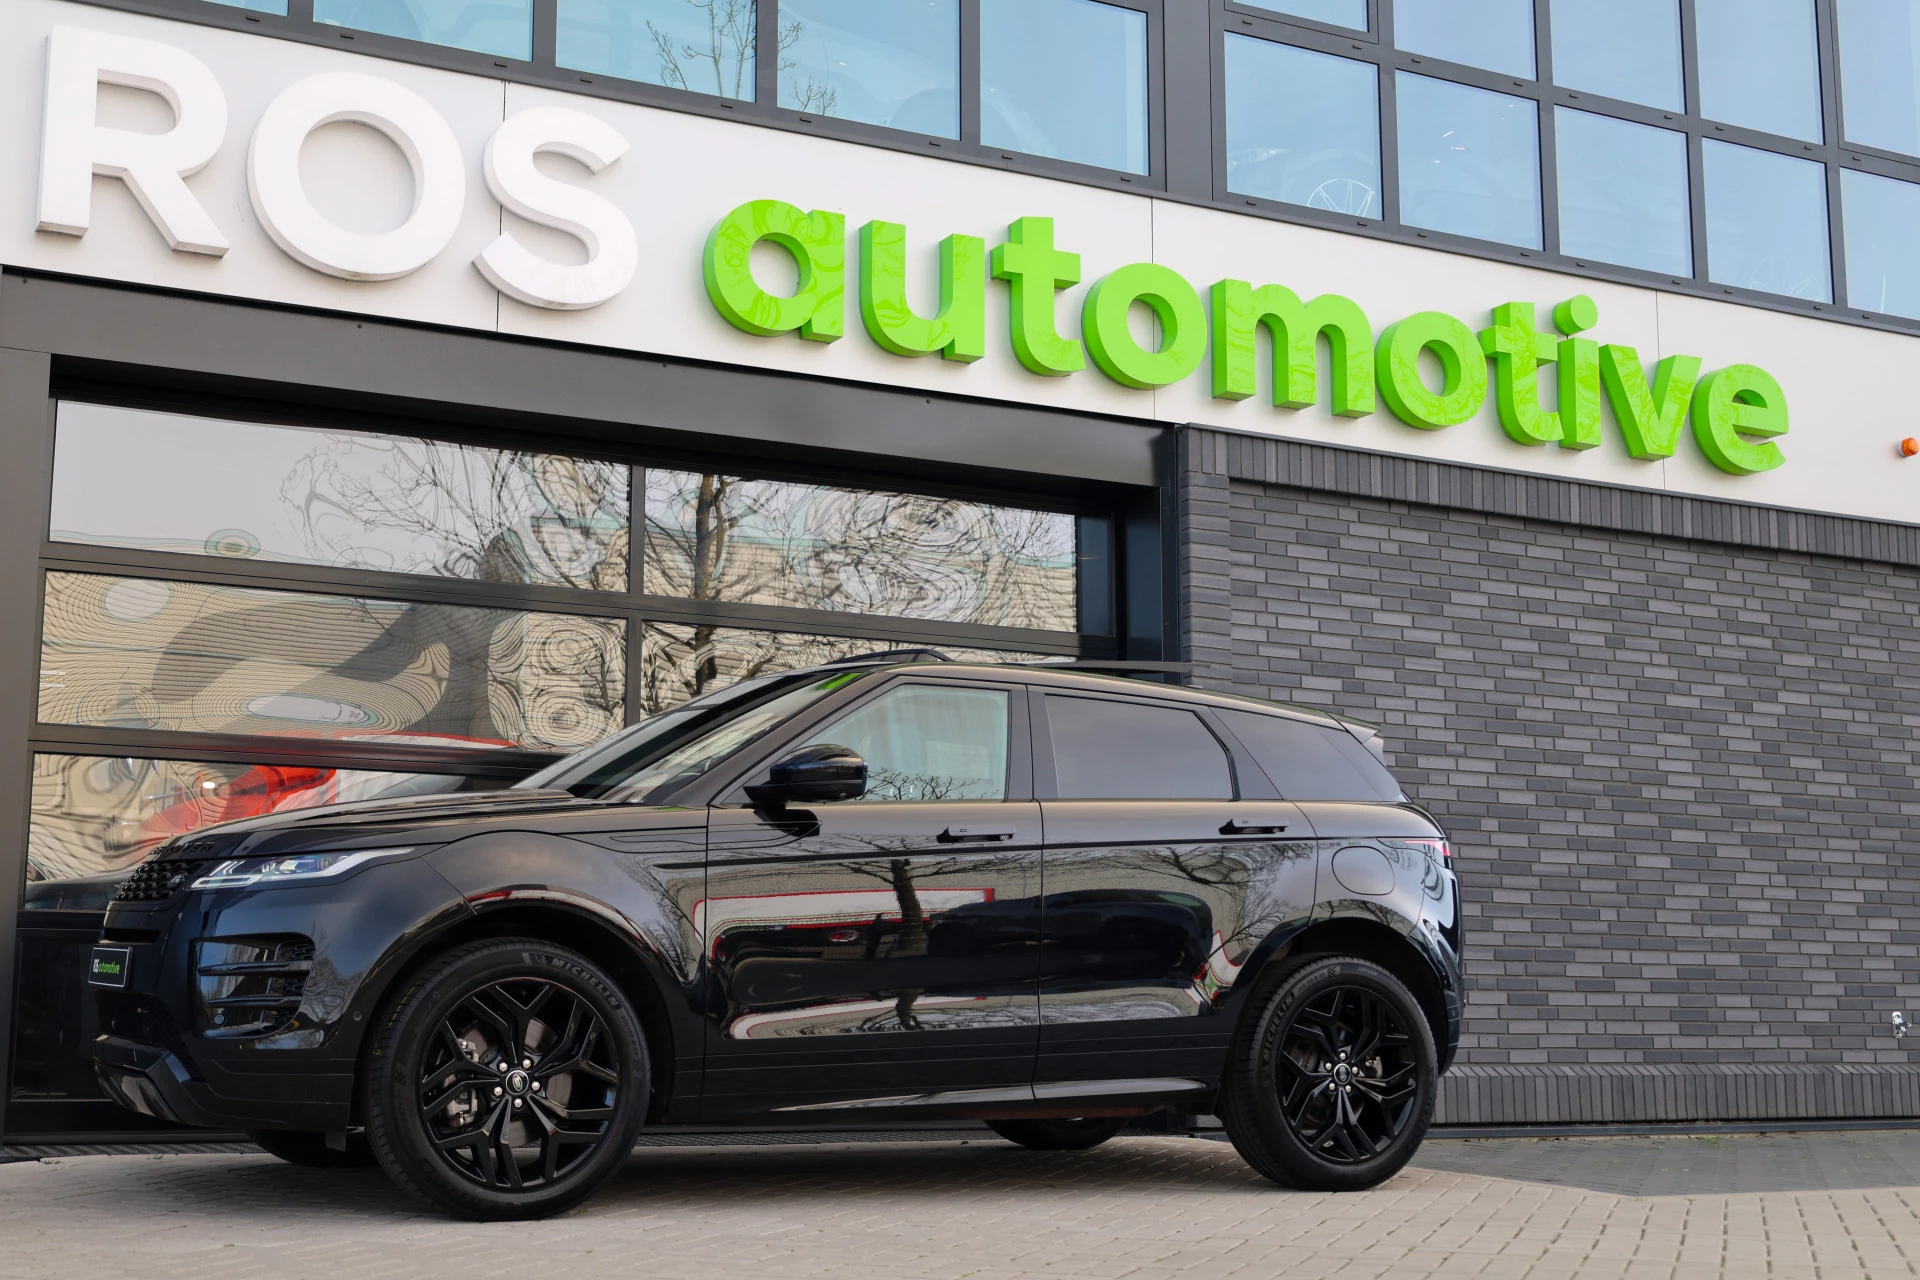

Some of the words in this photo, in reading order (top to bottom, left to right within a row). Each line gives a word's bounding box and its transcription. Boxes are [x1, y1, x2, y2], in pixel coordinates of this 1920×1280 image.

[35, 23, 639, 311] ROS
[702, 198, 1789, 477] automotive
[551, 958, 619, 1006] MICHELIN
[1263, 993, 1295, 1062] MICHELIN
